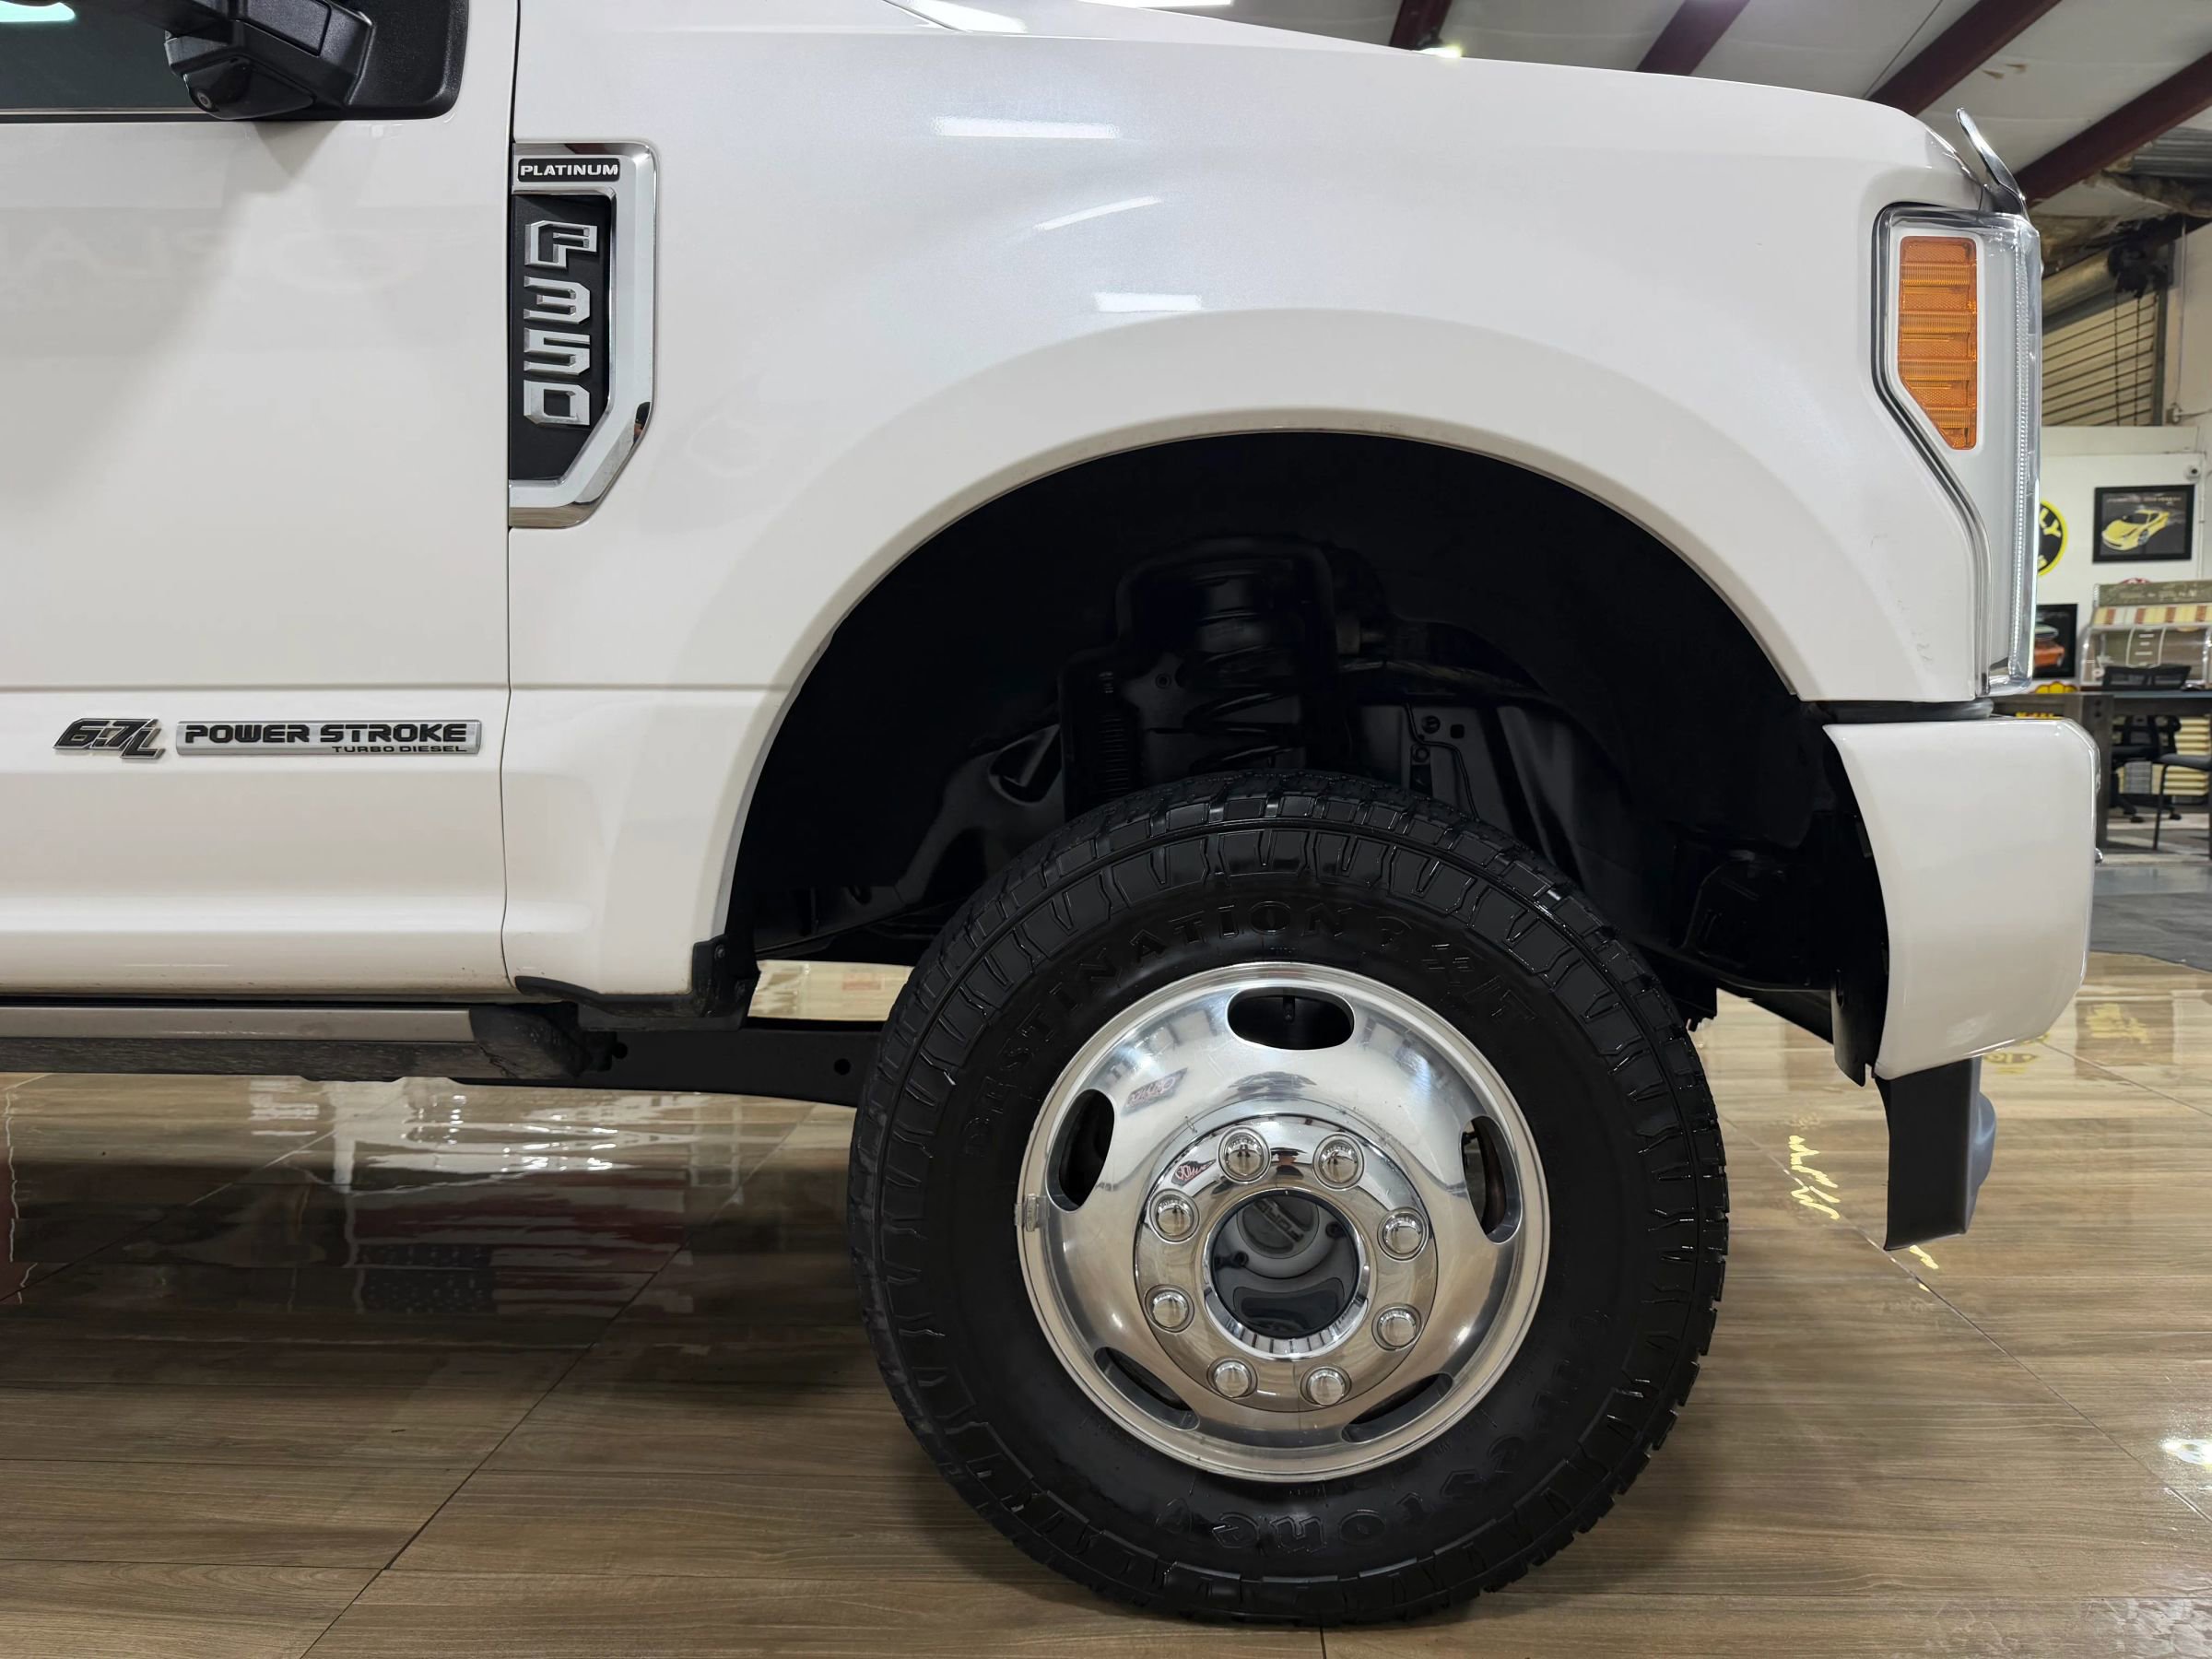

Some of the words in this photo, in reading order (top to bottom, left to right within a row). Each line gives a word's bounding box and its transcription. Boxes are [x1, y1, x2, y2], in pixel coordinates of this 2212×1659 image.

[520, 164, 618, 177] PLATINUM
[524, 220, 597, 426] F350
[53, 718, 165, 759] 6.7L
[184, 724, 309, 743] POWER
[320, 724, 467, 743] STROKE
[331, 746, 394, 754] TURBO
[399, 745, 467, 754] DIESEL
